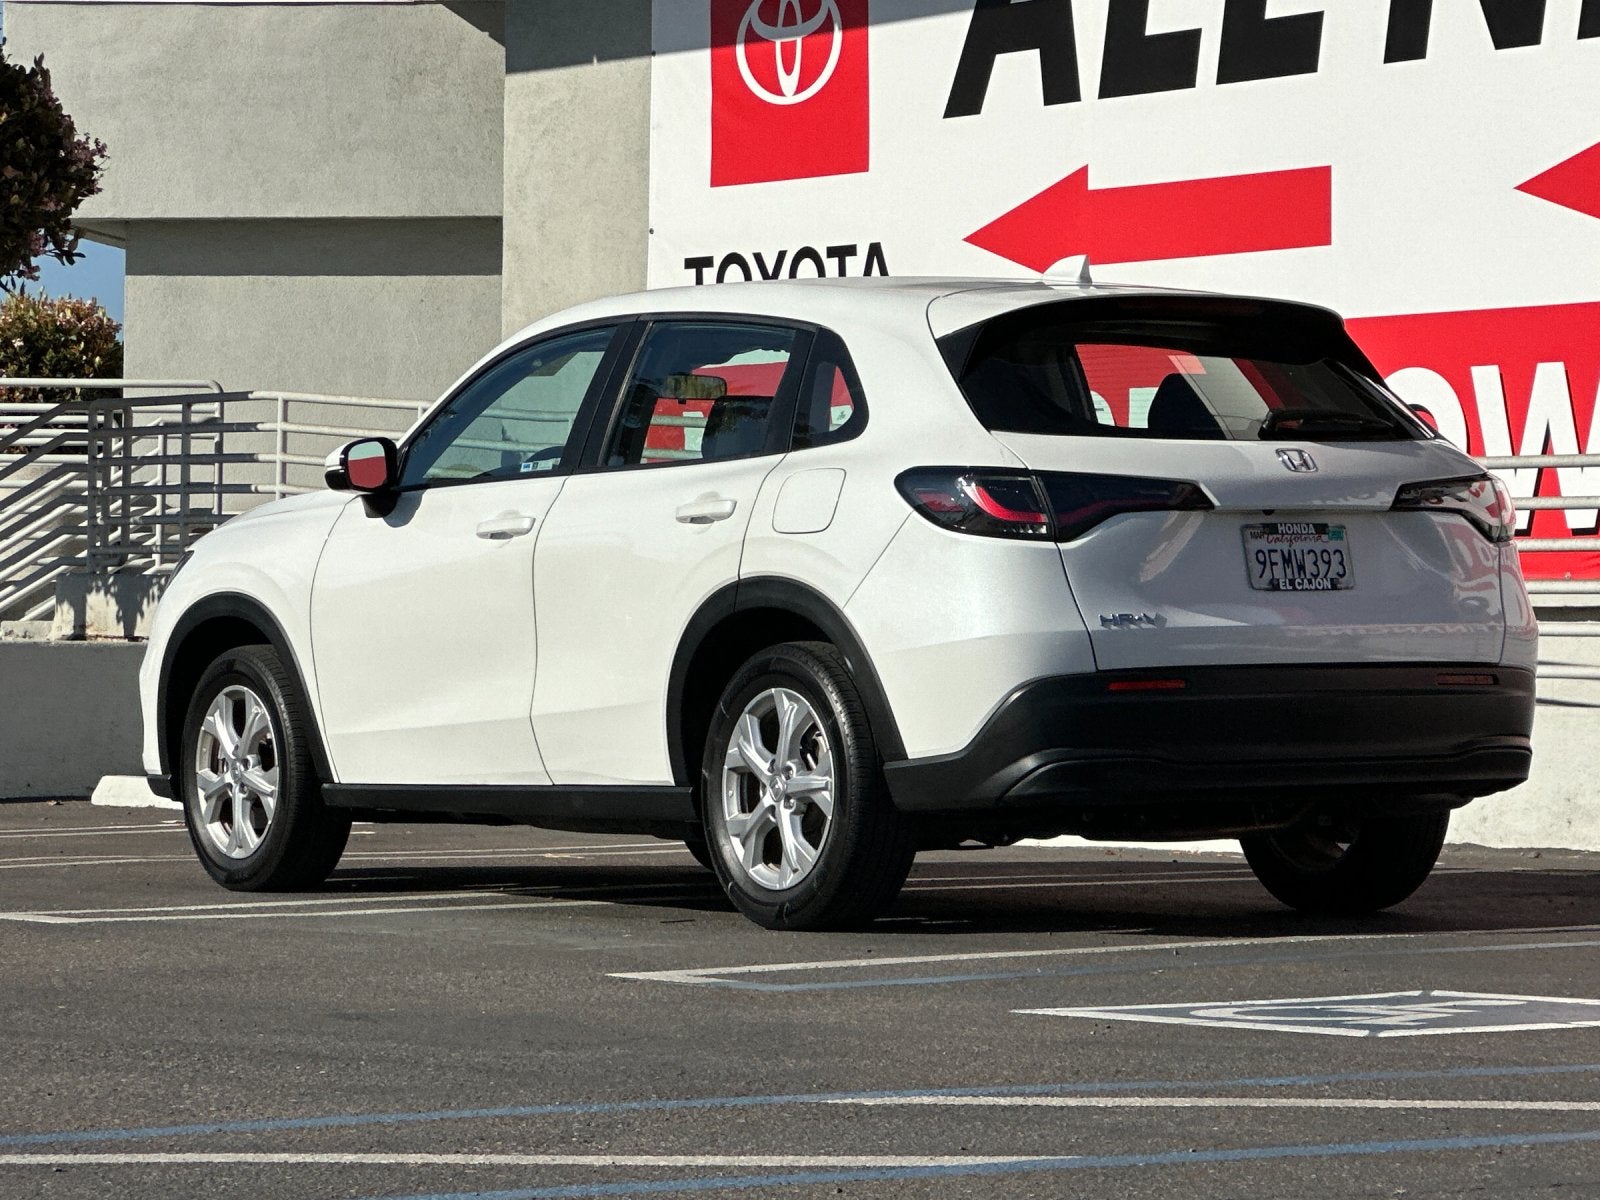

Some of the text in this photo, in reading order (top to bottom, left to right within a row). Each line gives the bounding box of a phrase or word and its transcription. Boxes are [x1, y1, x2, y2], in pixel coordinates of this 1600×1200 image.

[1277, 523, 1316, 534] HONDA
[1266, 533, 1330, 546] California
[1255, 548, 1347, 579] 9FMW393
[1279, 577, 1331, 590] EL CAJON
